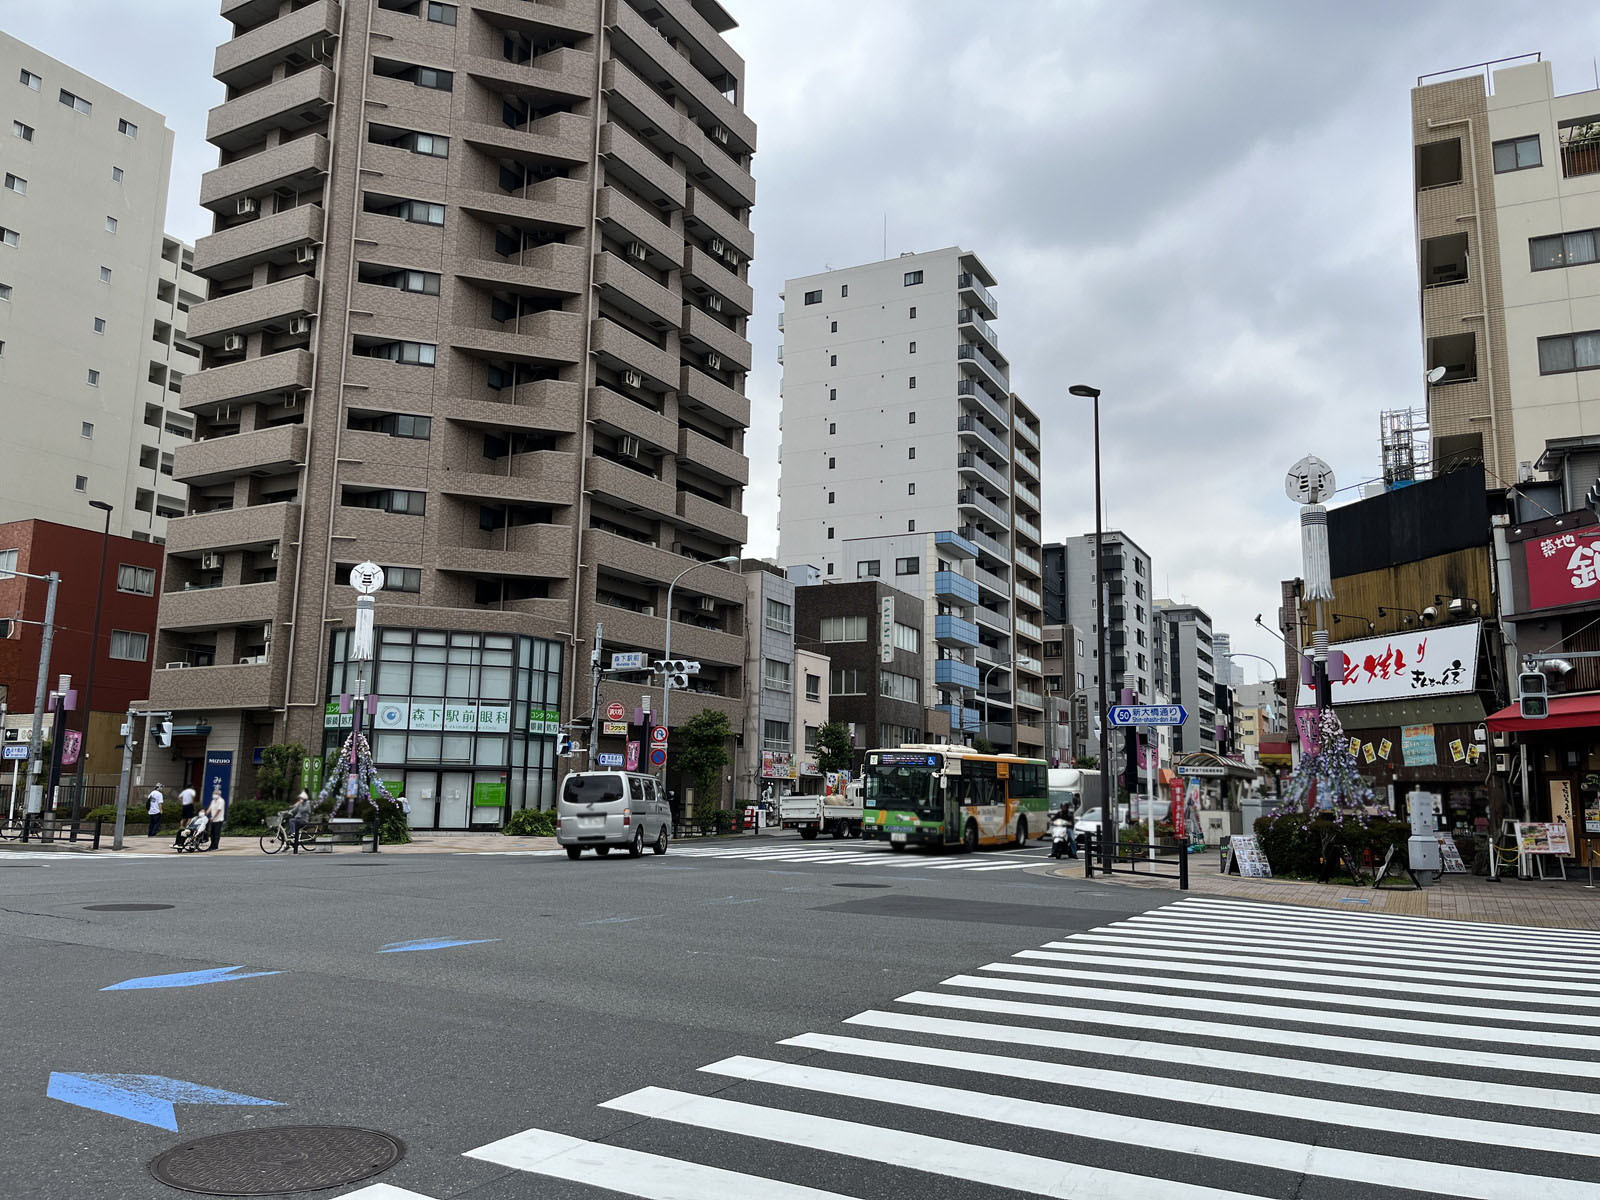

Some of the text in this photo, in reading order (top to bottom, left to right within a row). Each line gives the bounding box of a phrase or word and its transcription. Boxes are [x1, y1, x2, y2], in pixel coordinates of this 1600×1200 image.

[1540, 535, 1576, 558] 築地
[1411, 659, 1467, 689] きんちゃん家
[411, 708, 509, 724] 森下駅前眼科
[1119, 711, 1129, 720] 50
[1132, 707, 1178, 716] 新大橋通り
